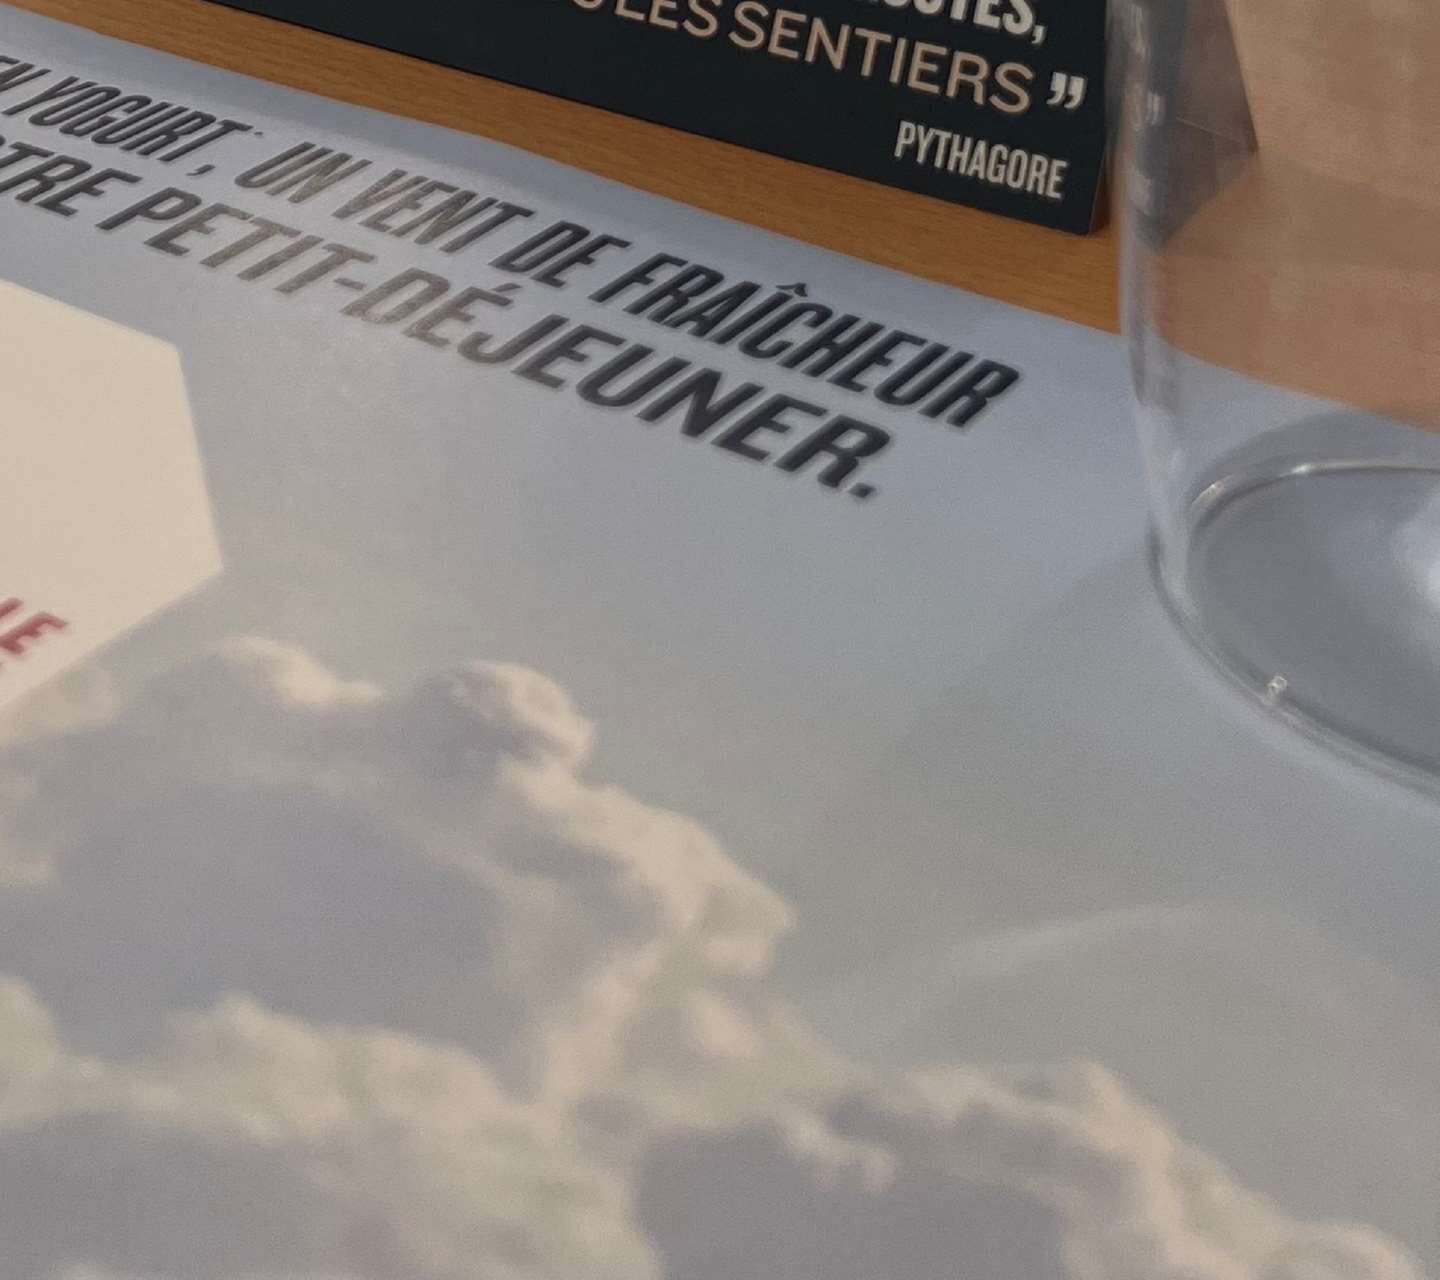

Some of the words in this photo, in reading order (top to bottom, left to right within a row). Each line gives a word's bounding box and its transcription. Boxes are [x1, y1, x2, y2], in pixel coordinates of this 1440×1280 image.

[235, 141, 372, 203] UN
[333, 168, 535, 254] VENT
[491, 220, 632, 288] DE
[590, 252, 1020, 427] FRAÎCHEUR
[894, 121, 1068, 201] PYTHAGORE
[95, 187, 896, 499] PETIT-DÉJEUNER.
